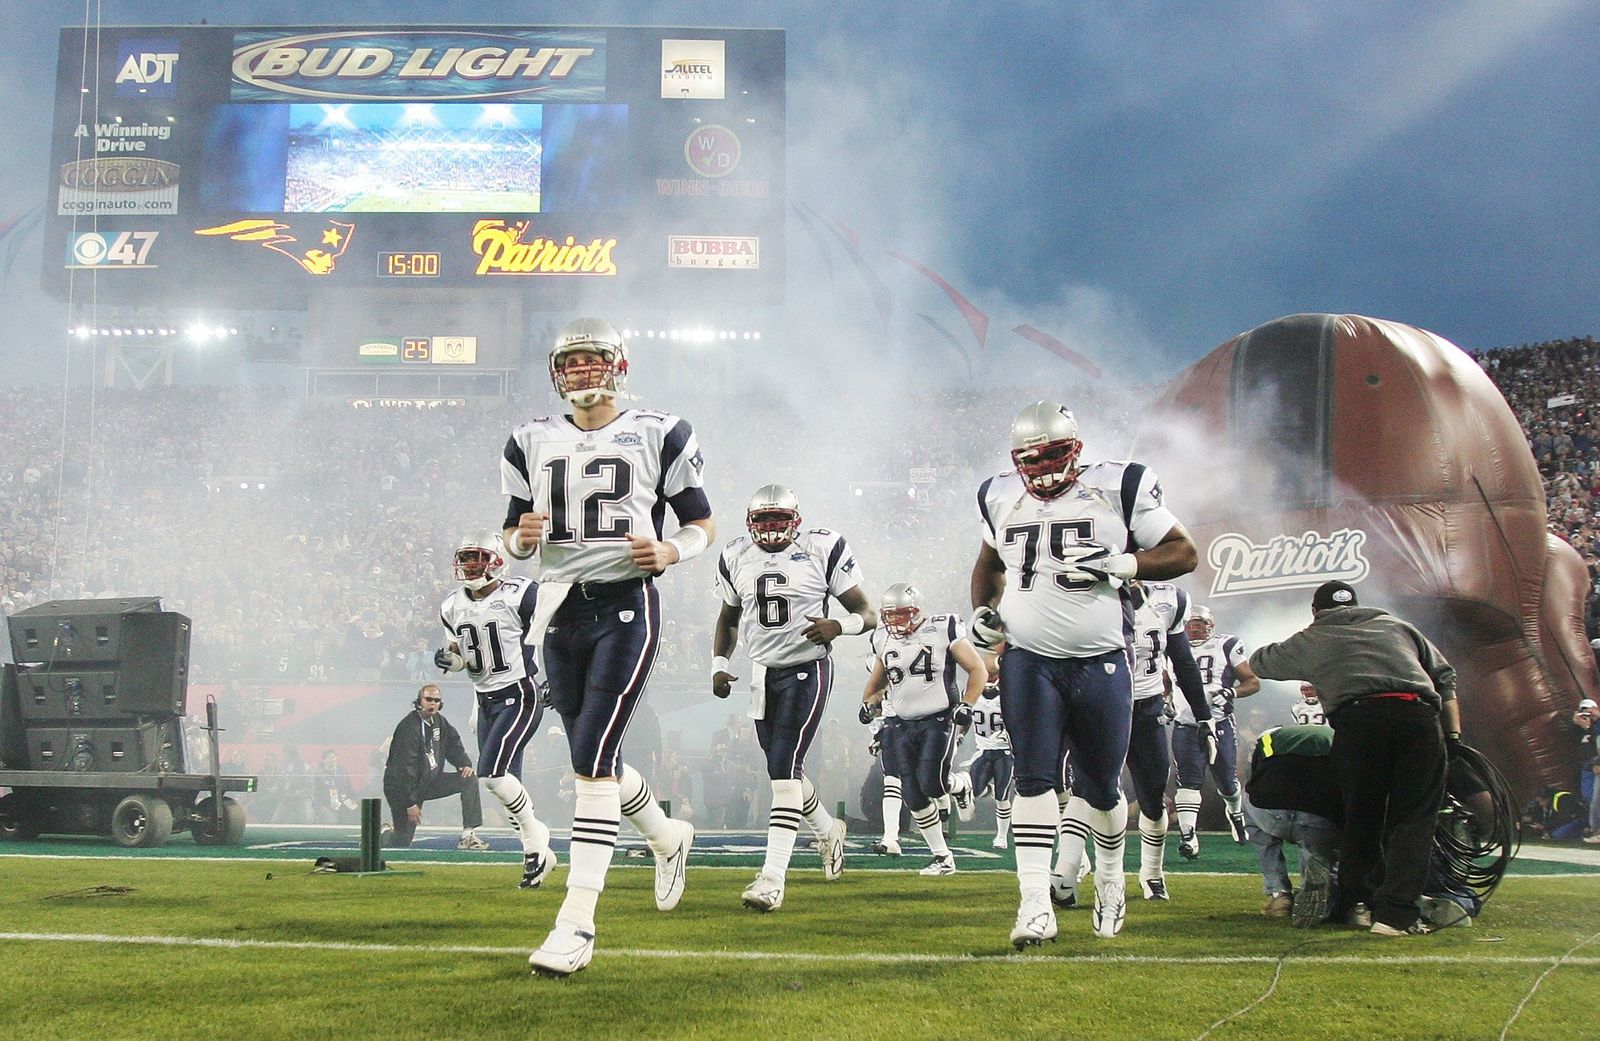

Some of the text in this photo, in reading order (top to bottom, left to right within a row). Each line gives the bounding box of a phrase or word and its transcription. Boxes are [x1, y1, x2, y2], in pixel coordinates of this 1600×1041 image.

[115, 53, 179, 83] ADT
[251, 47, 594, 80] BUD LIGHT
[665, 64, 713, 74] ALLTEL
[74, 123, 171, 140] A Winning
[97, 138, 146, 152] Drive
[64, 167, 171, 186] COGGIN
[107, 231, 160, 265] 47
[472, 228, 617, 275] Patriots
[673, 240, 754, 255] BUBBA
[676, 257, 751, 267] burger
[389, 254, 438, 275] 15:00
[404, 341, 428, 359] 25
[542, 455, 634, 544] 12
[1003, 518, 1096, 592] 75
[1208, 529, 1370, 598] Patriots
[754, 571, 791, 630] 6
[455, 619, 512, 676] 31
[883, 645, 937, 686] 64
